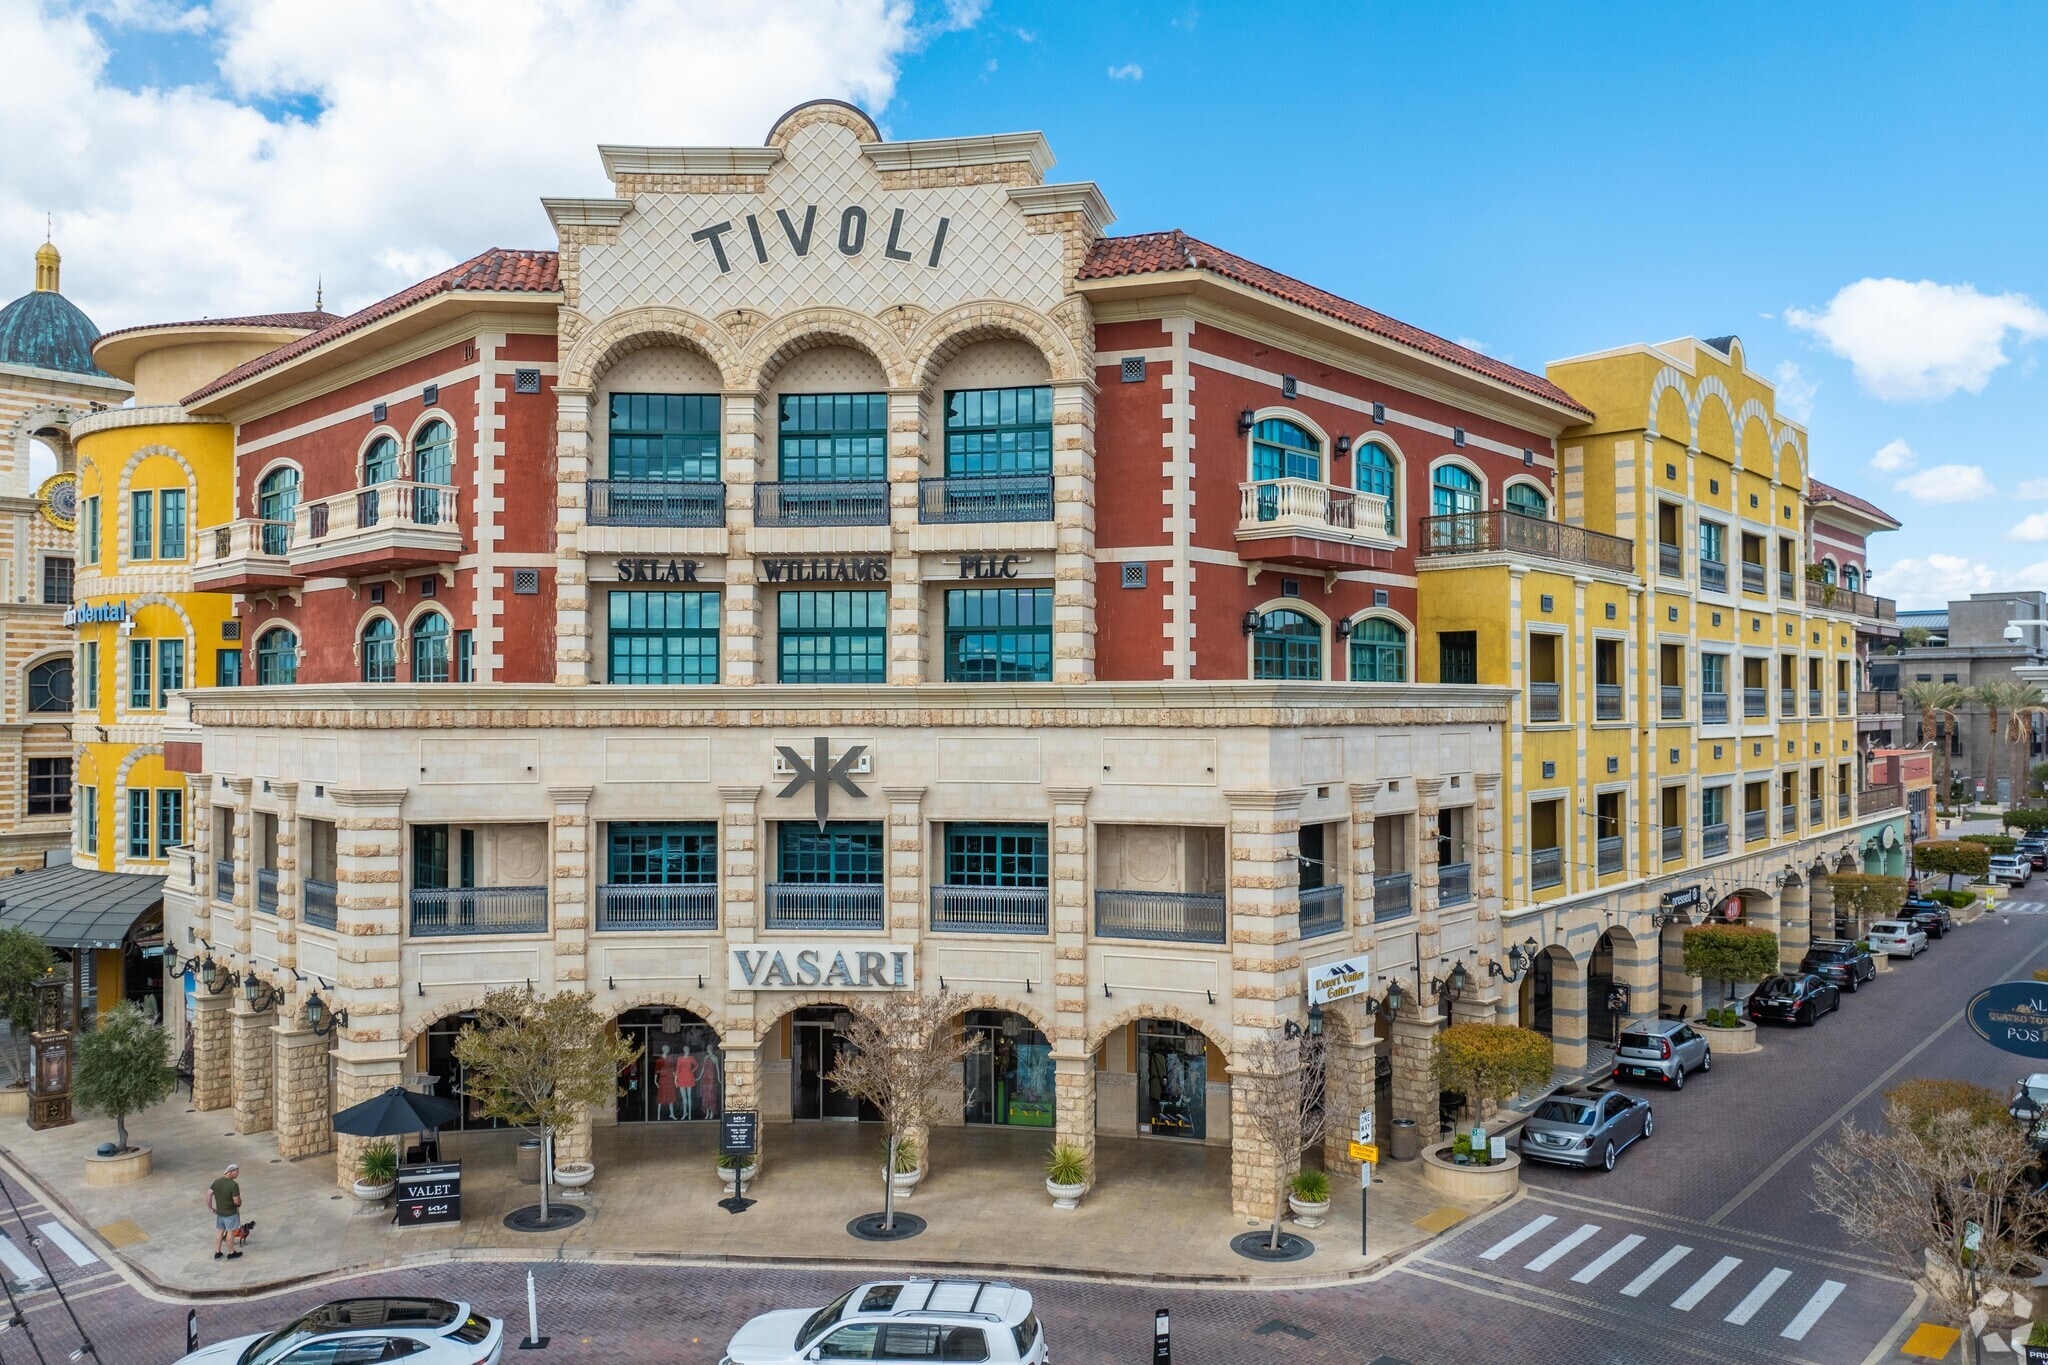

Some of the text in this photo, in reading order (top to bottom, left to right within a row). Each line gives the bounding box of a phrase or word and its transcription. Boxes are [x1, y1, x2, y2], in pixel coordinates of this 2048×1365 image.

[690, 204, 950, 275] TIVOLI
[618, 555, 1018, 582] SKLAR WILLIAMS PLLC
[77, 601, 125, 624] dental
[733, 950, 908, 987] VASARI
[1342, 970, 1366, 983] Valley
[1327, 984, 1356, 999] Gallery
[408, 1184, 451, 1197] VALET
